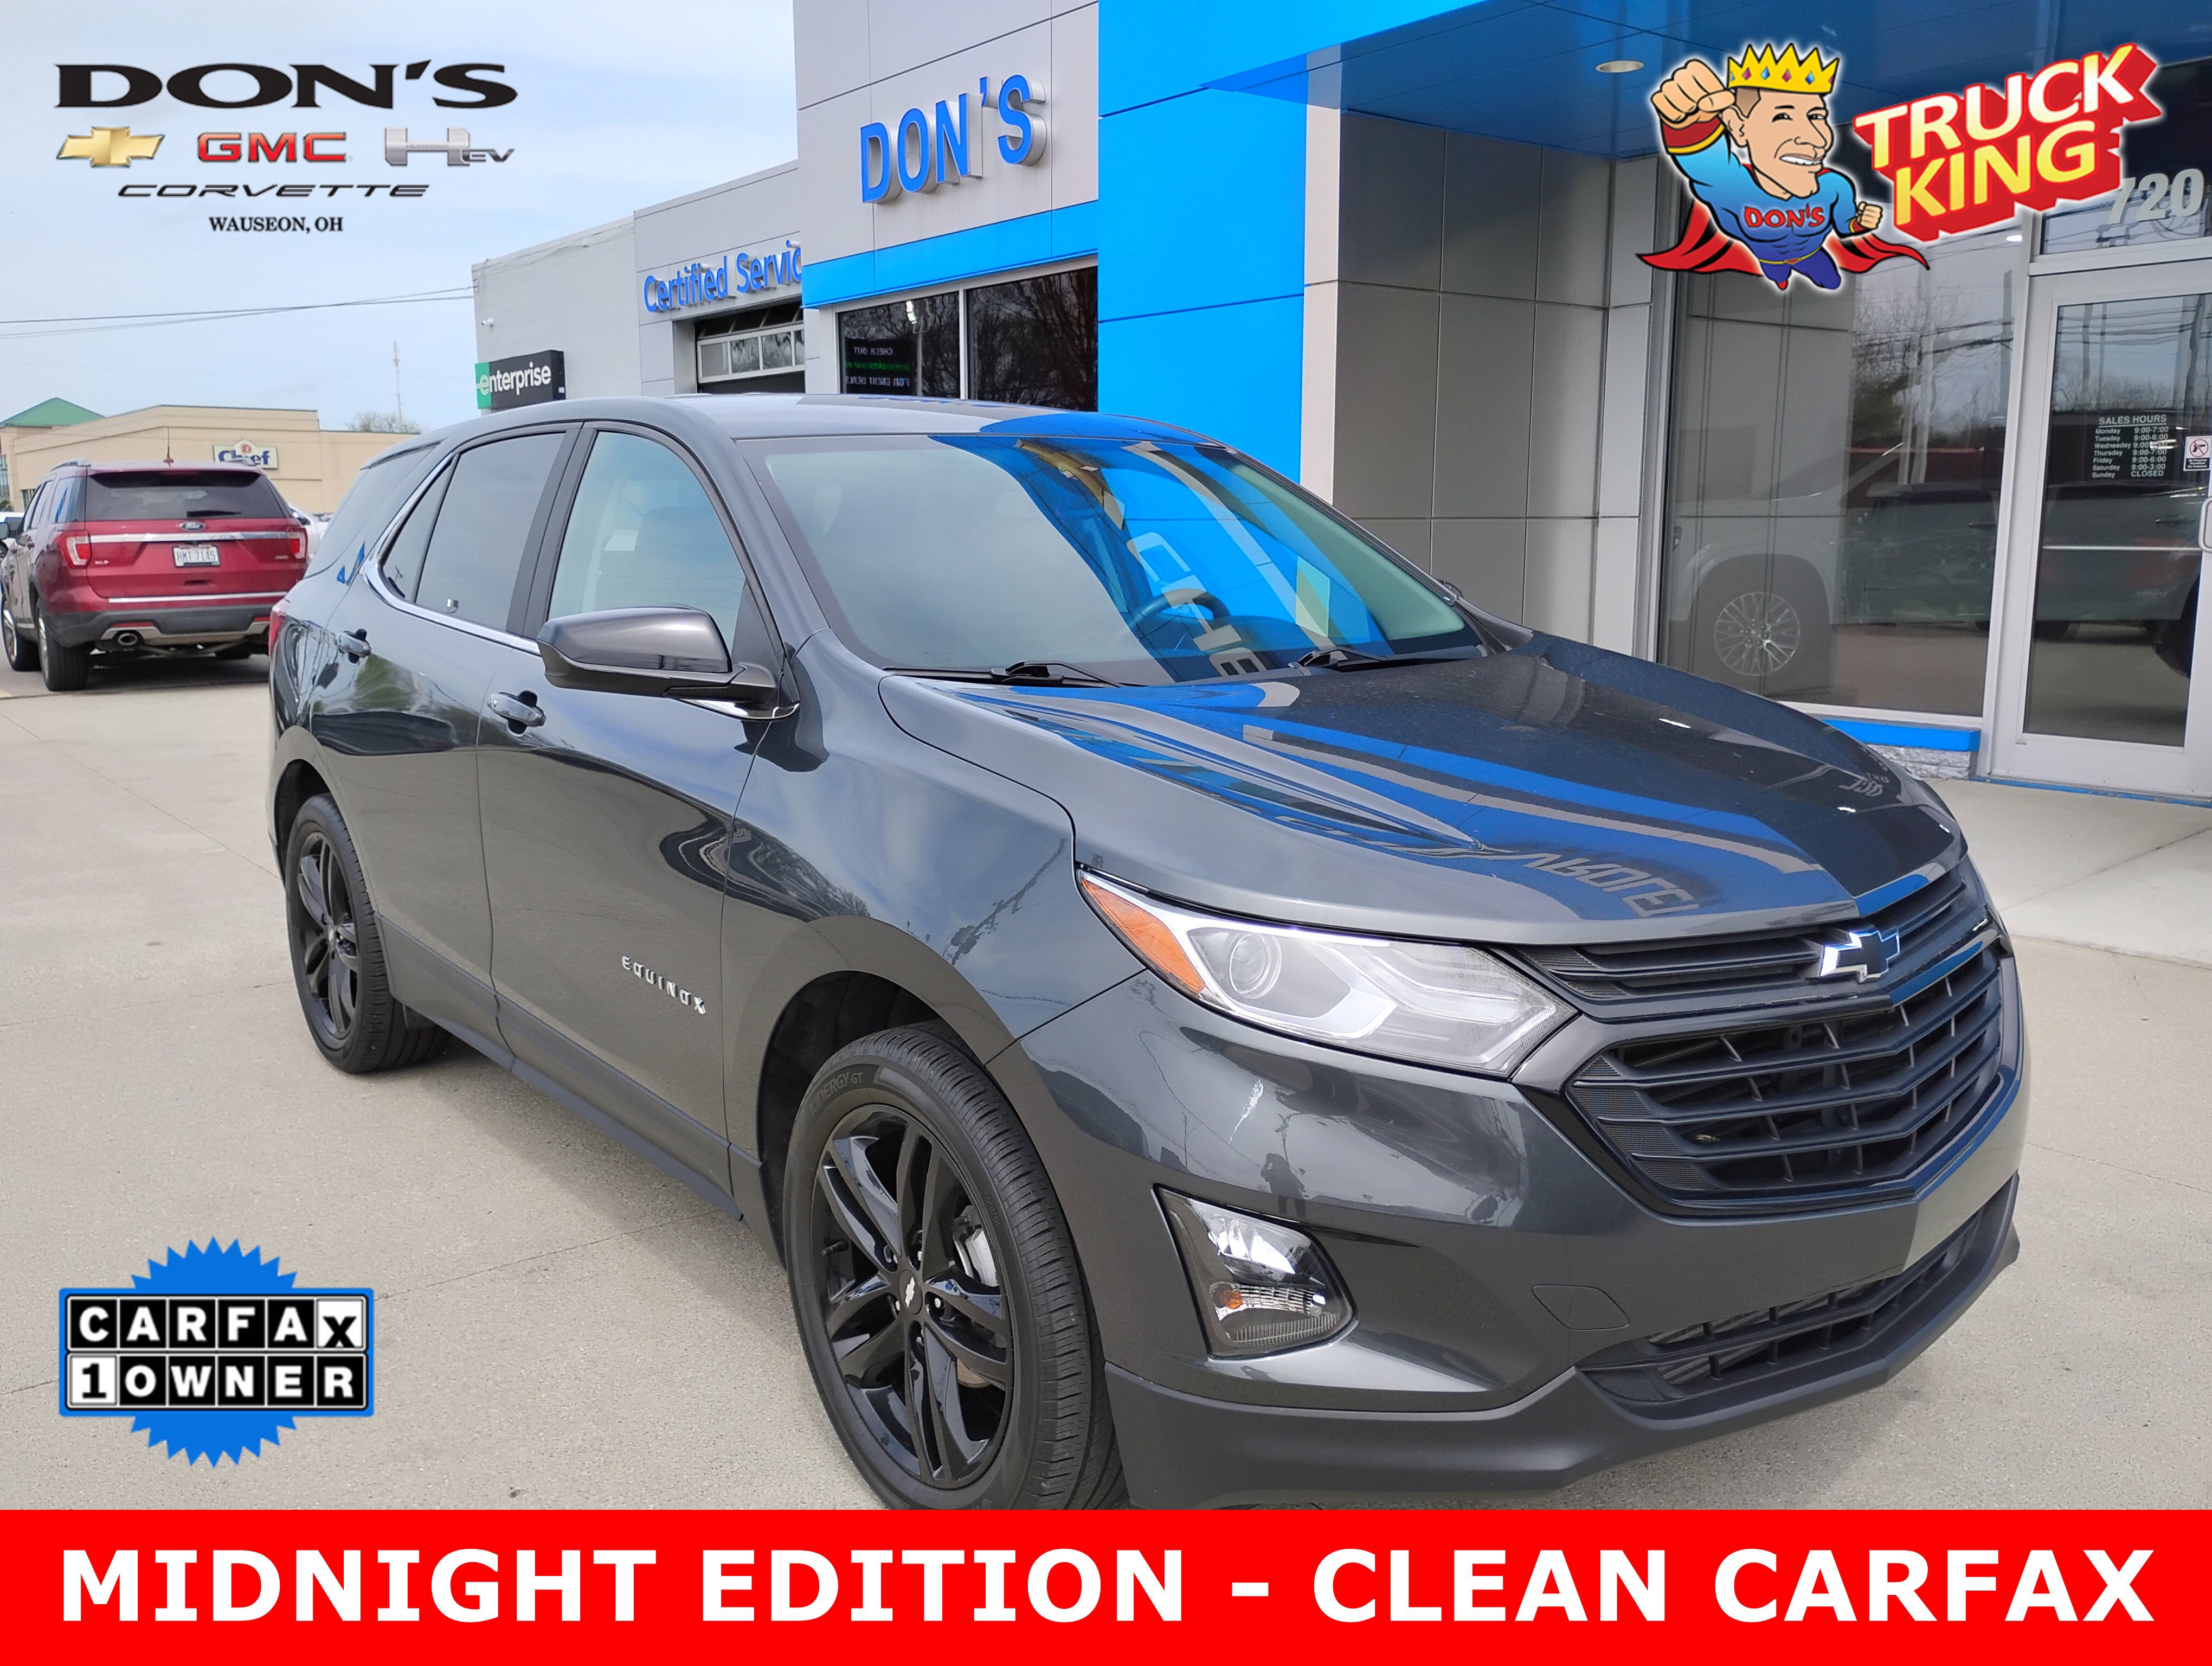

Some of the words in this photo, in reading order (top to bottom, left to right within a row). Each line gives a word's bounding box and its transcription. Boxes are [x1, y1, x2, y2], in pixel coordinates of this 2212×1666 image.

[859, 74, 1037, 203] DON'S
[2107, 168, 2205, 226] 720
[644, 254, 729, 313] Certified
[476, 361, 552, 396] enterprise
[2099, 415, 2130, 425] SALES
[2132, 414, 2167, 424] HOURS
[621, 954, 706, 1015] EQUINOX
